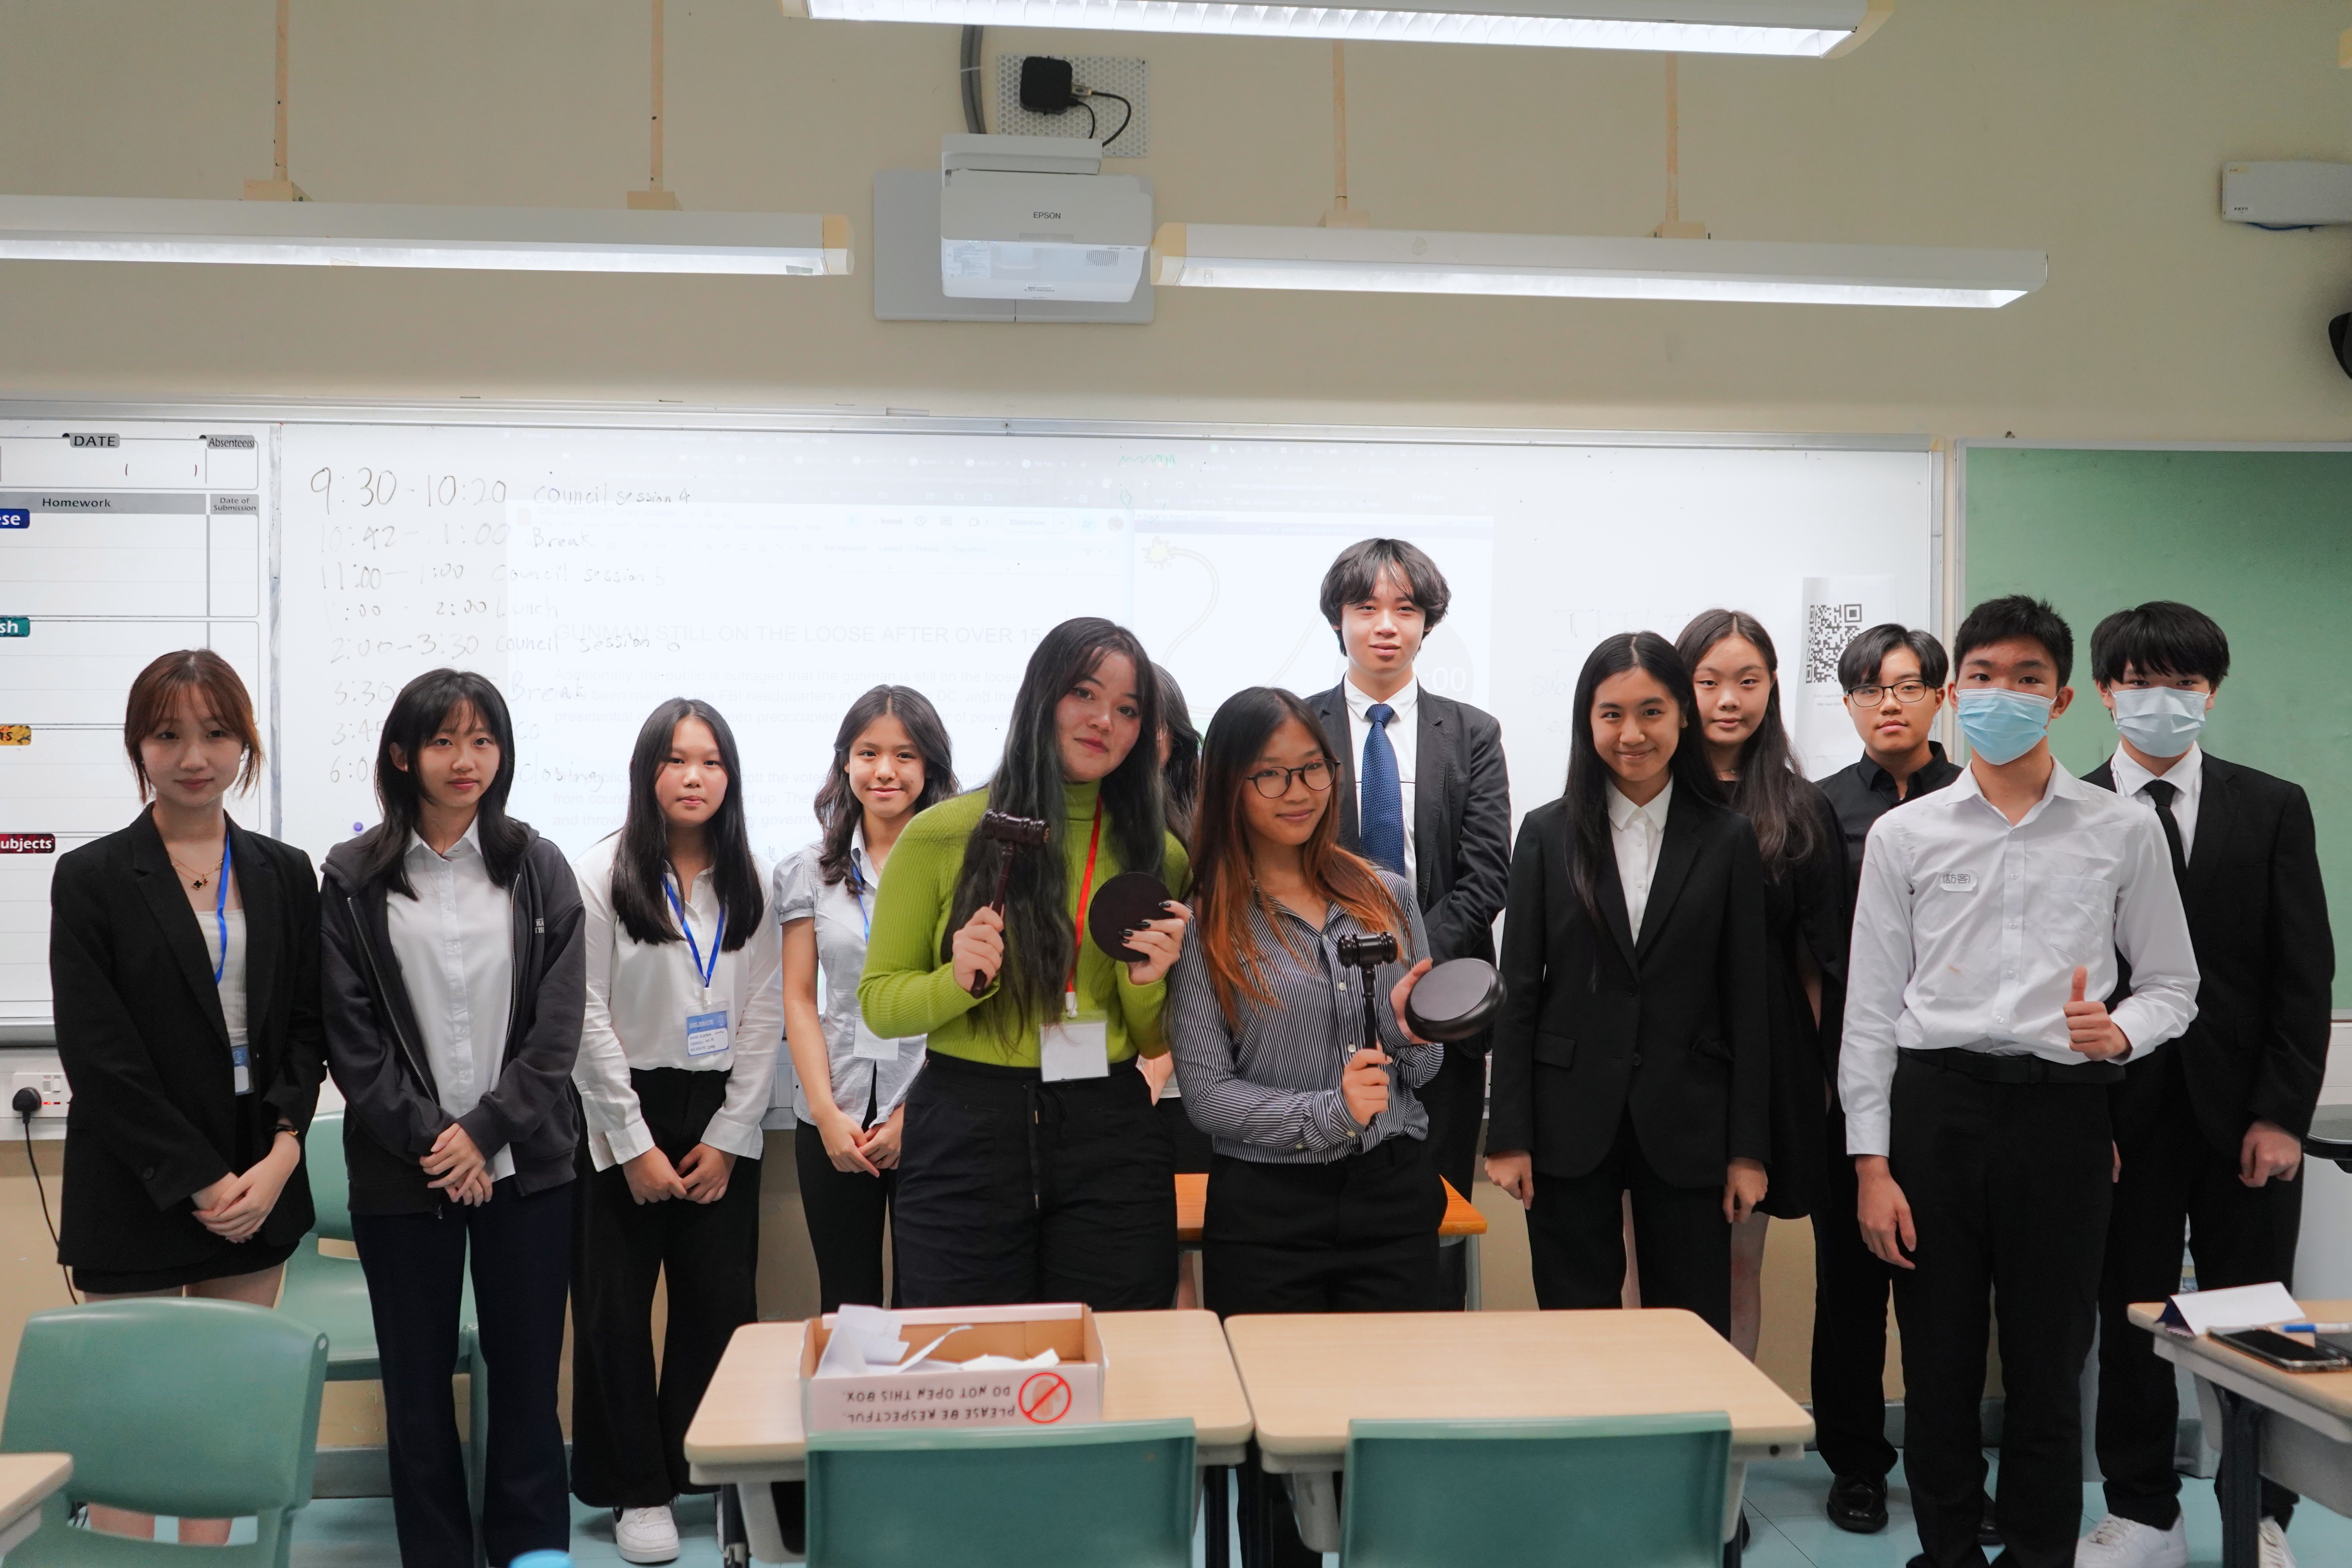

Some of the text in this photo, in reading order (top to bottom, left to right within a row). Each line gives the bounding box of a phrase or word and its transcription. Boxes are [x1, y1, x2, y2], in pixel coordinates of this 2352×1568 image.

[74, 436, 115, 447] DATE
[208, 438, 255, 448] Absentee(s)
[43, 497, 111, 508] Homework
[1412, 492, 1445, 502] Freeze
[539, 507, 586, 516] DELEGATE
[588, 508, 614, 517] COPY
[641, 509, 677, 518] updates
[0, 515, 21, 525] se
[880, 517, 903, 525] kami
[533, 526, 591, 548] Break
[555, 624, 649, 641] GUNMAN
[656, 626, 711, 642] STILL
[718, 626, 749, 642] ON
[756, 626, 797, 642] THE
[804, 626, 875, 642] LOOSE
[881, 627, 949, 643] AFTER
[955, 627, 1013, 644] OVER
[554, 669, 635, 683] Additionally,
[640, 670, 661, 681] the
[666, 670, 706, 683] public
[709, 670, 720, 681] is
[724, 670, 784, 684] outraged
[788, 670, 815, 682] that
[818, 670, 838, 682] the
[842, 673, 896, 684] gunman
[900, 671, 911, 682] is
[914, 670, 936, 682] still
[940, 673, 957, 682] on
[961, 671, 981, 682] the
[594, 690, 627, 701] been
[719, 690, 742, 702] FBI
[747, 690, 836, 705] headquarters
[839, 690, 851, 702] in
[554, 711, 633, 725] presidential
[757, 711, 838, 725] preoccupied
[553, 792, 584, 804] from
[553, 814, 578, 826] and
[881, 1388, 911, 1400] THIS
[917, 1387, 954, 1400] OPEN
[961, 1385, 987, 1398] NOT
[993, 1386, 1011, 1397] DO
[941, 1410, 959, 1421] BE
[965, 1405, 1015, 1420] PLEASE
